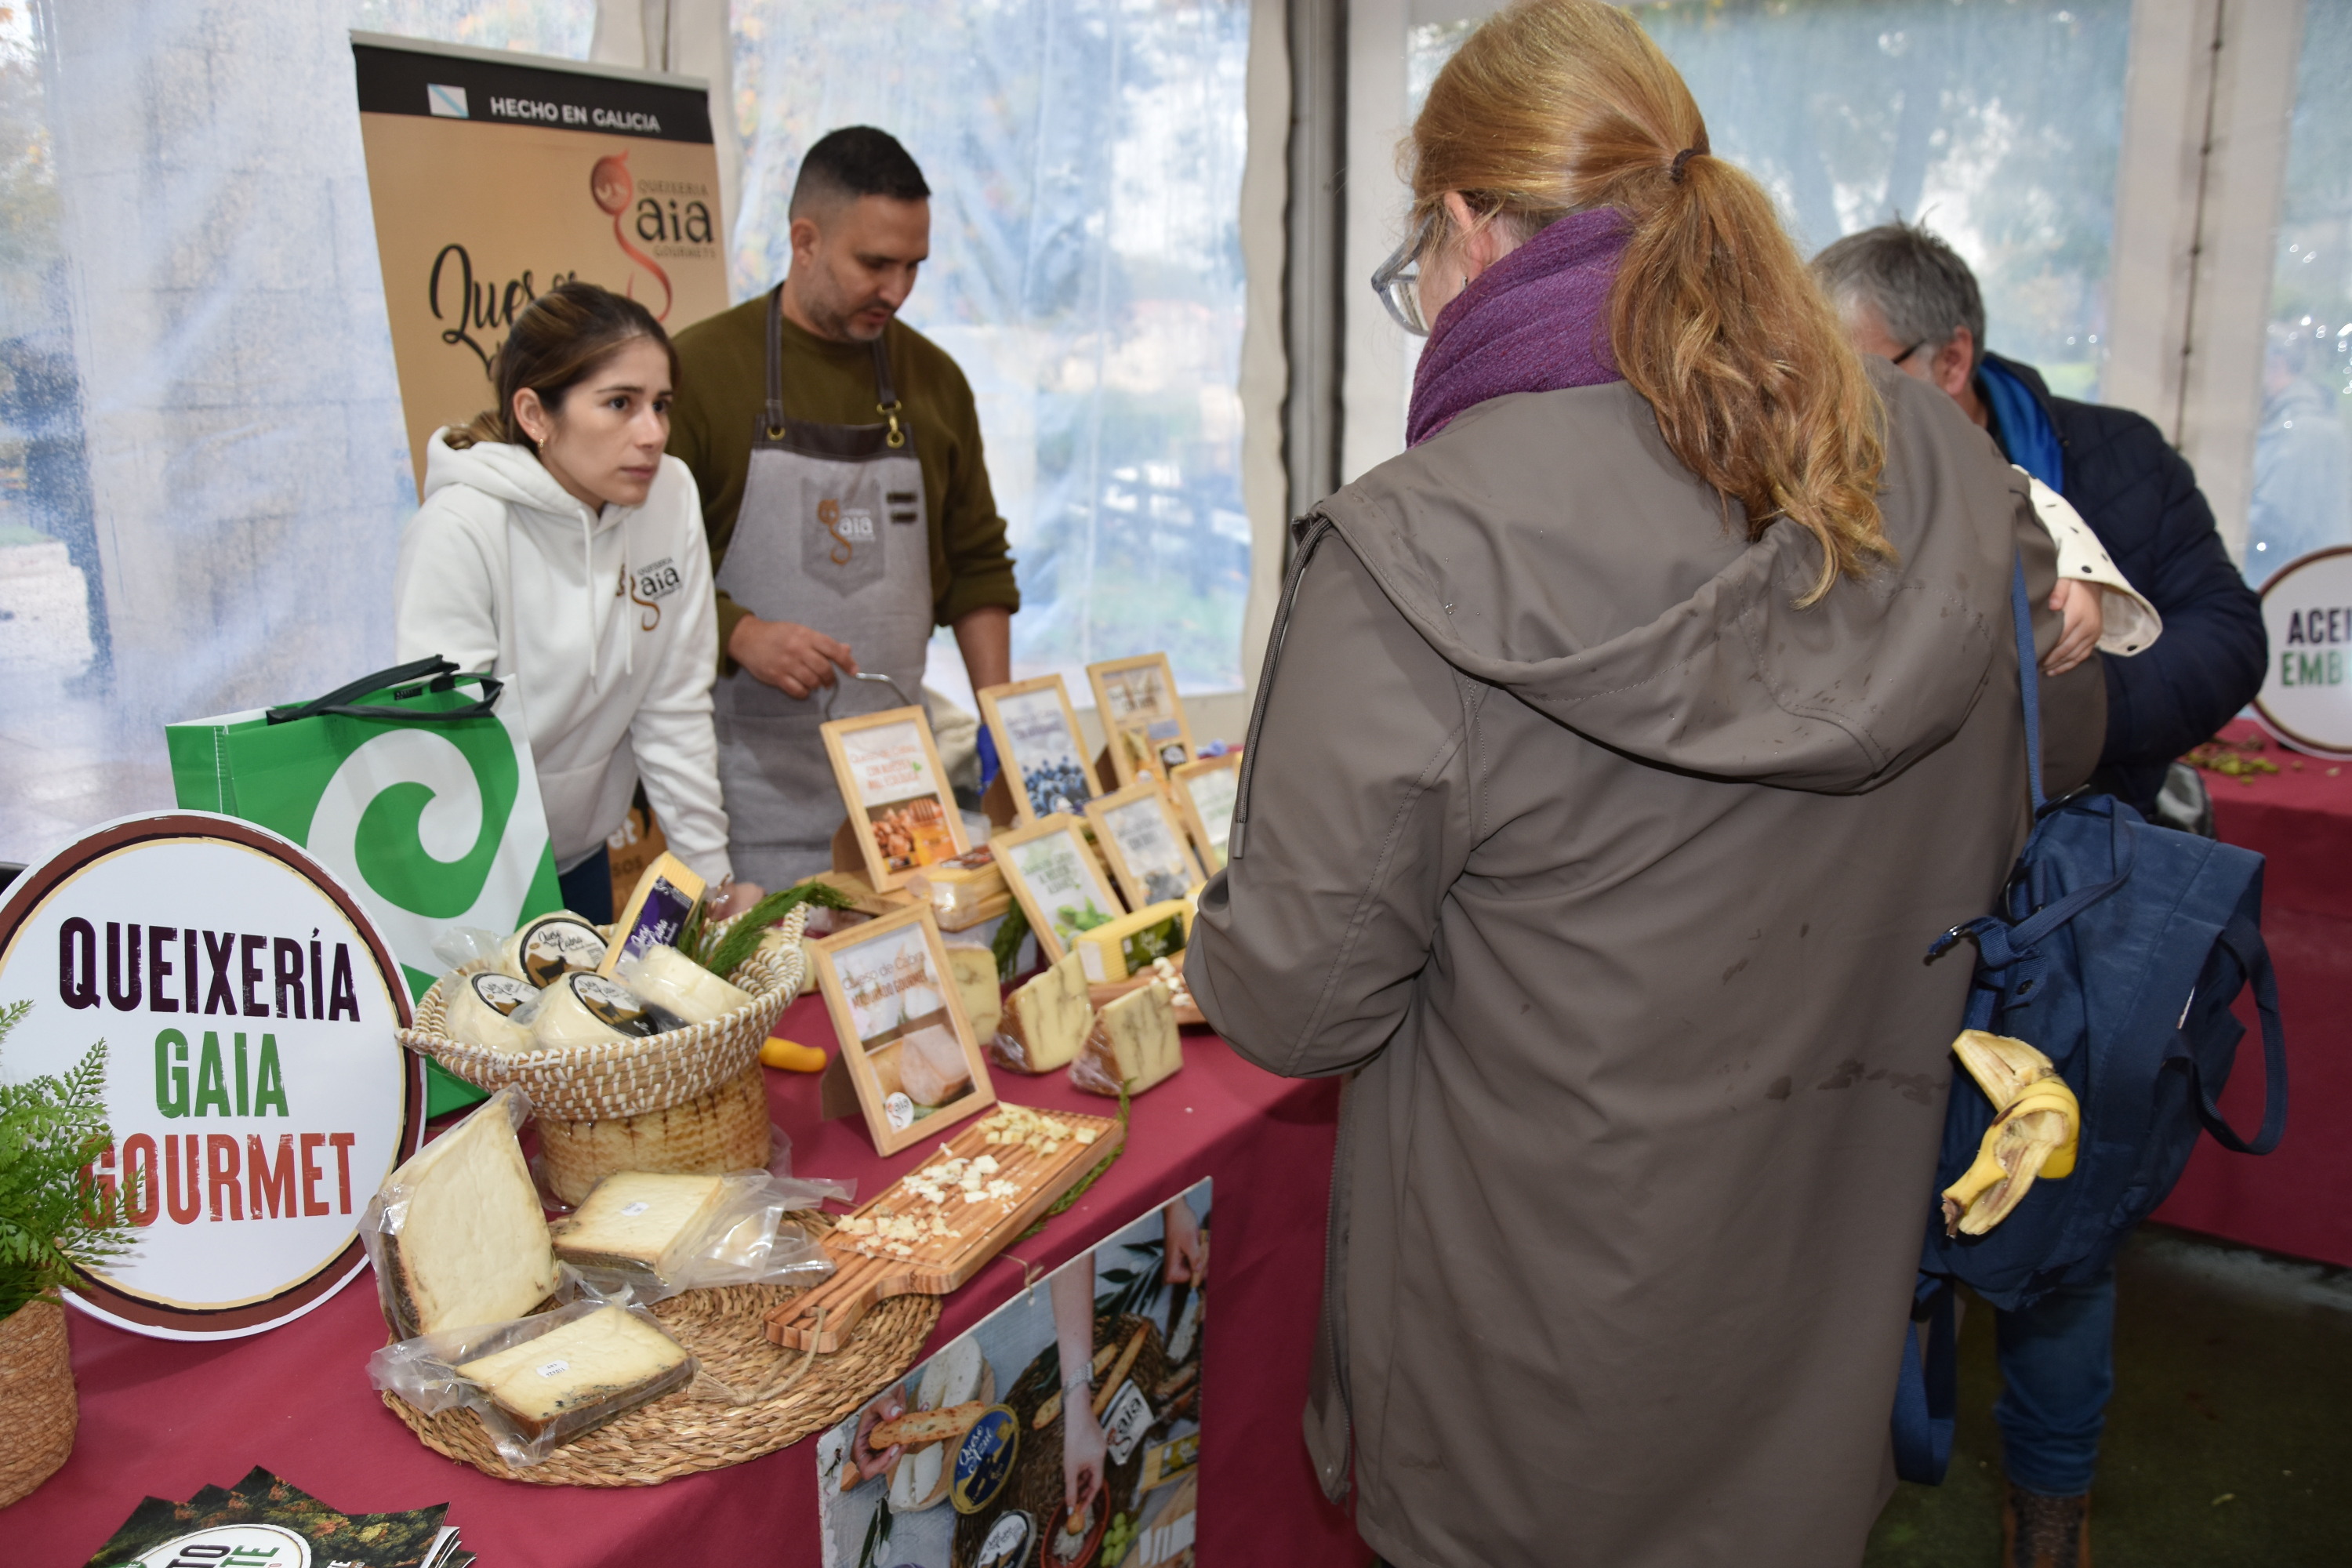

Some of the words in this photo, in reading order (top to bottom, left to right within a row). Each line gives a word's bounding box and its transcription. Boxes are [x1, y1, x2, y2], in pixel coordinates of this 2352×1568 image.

[490, 96, 559, 122] HECHO
[561, 104, 588, 125] EN
[592, 108, 662, 133] GALICIA
[59, 916, 361, 1022] QUEIXERÍA
[154, 1028, 290, 1119] GAIA
[79, 1132, 355, 1229] GOURMET
